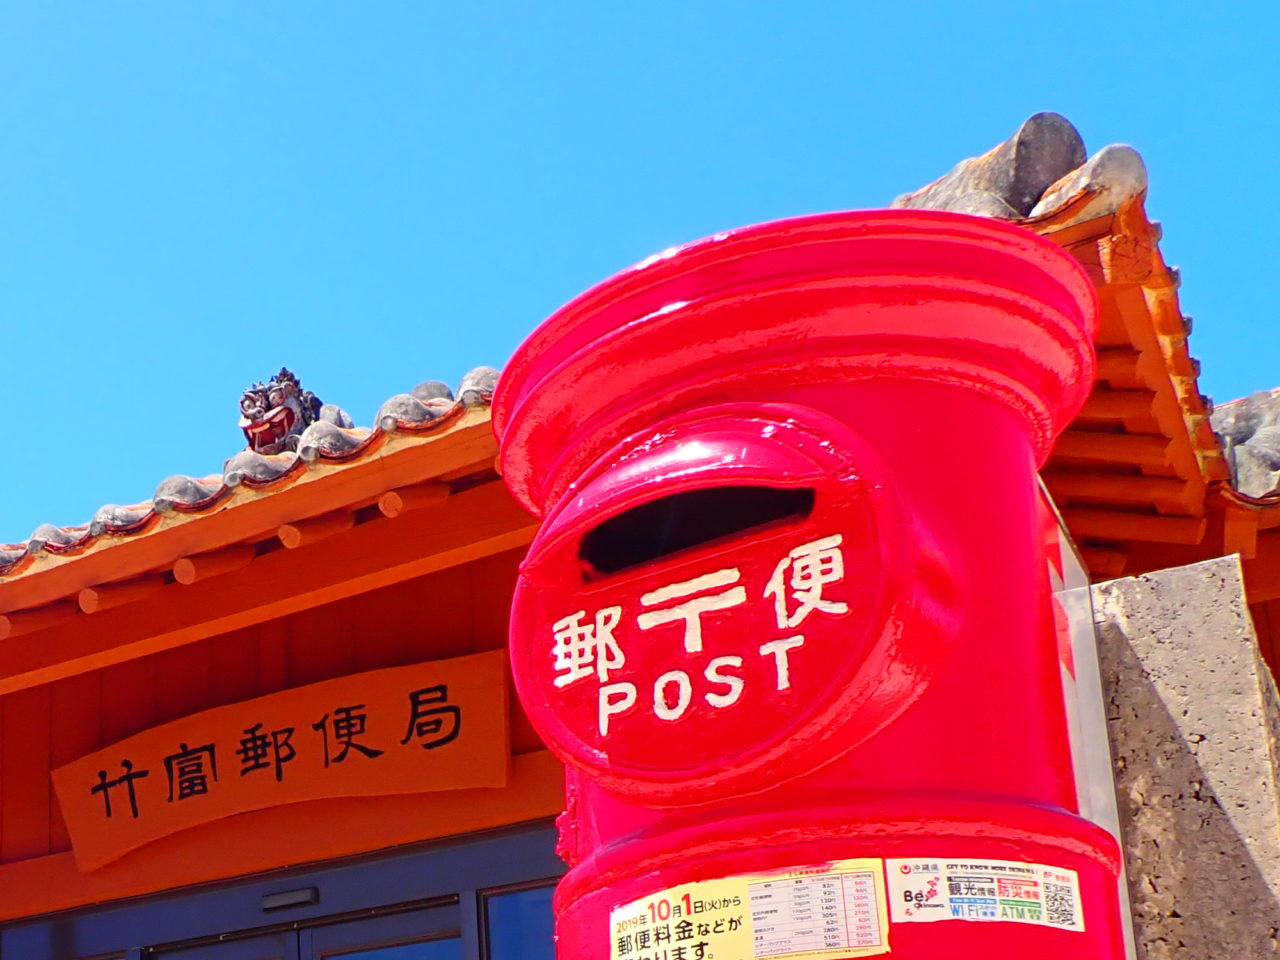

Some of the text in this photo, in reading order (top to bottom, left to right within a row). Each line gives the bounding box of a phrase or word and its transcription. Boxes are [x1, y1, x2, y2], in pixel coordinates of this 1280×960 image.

[598, 635, 804, 736] POST
[90, 684, 462, 818] 竹富郵便局
[948, 883, 996, 897] 観光情報
[998, 885, 1040, 900] 防災情報
[1001, 907, 1025, 919] ATM
[617, 915, 743, 957] 郵便料金などが
